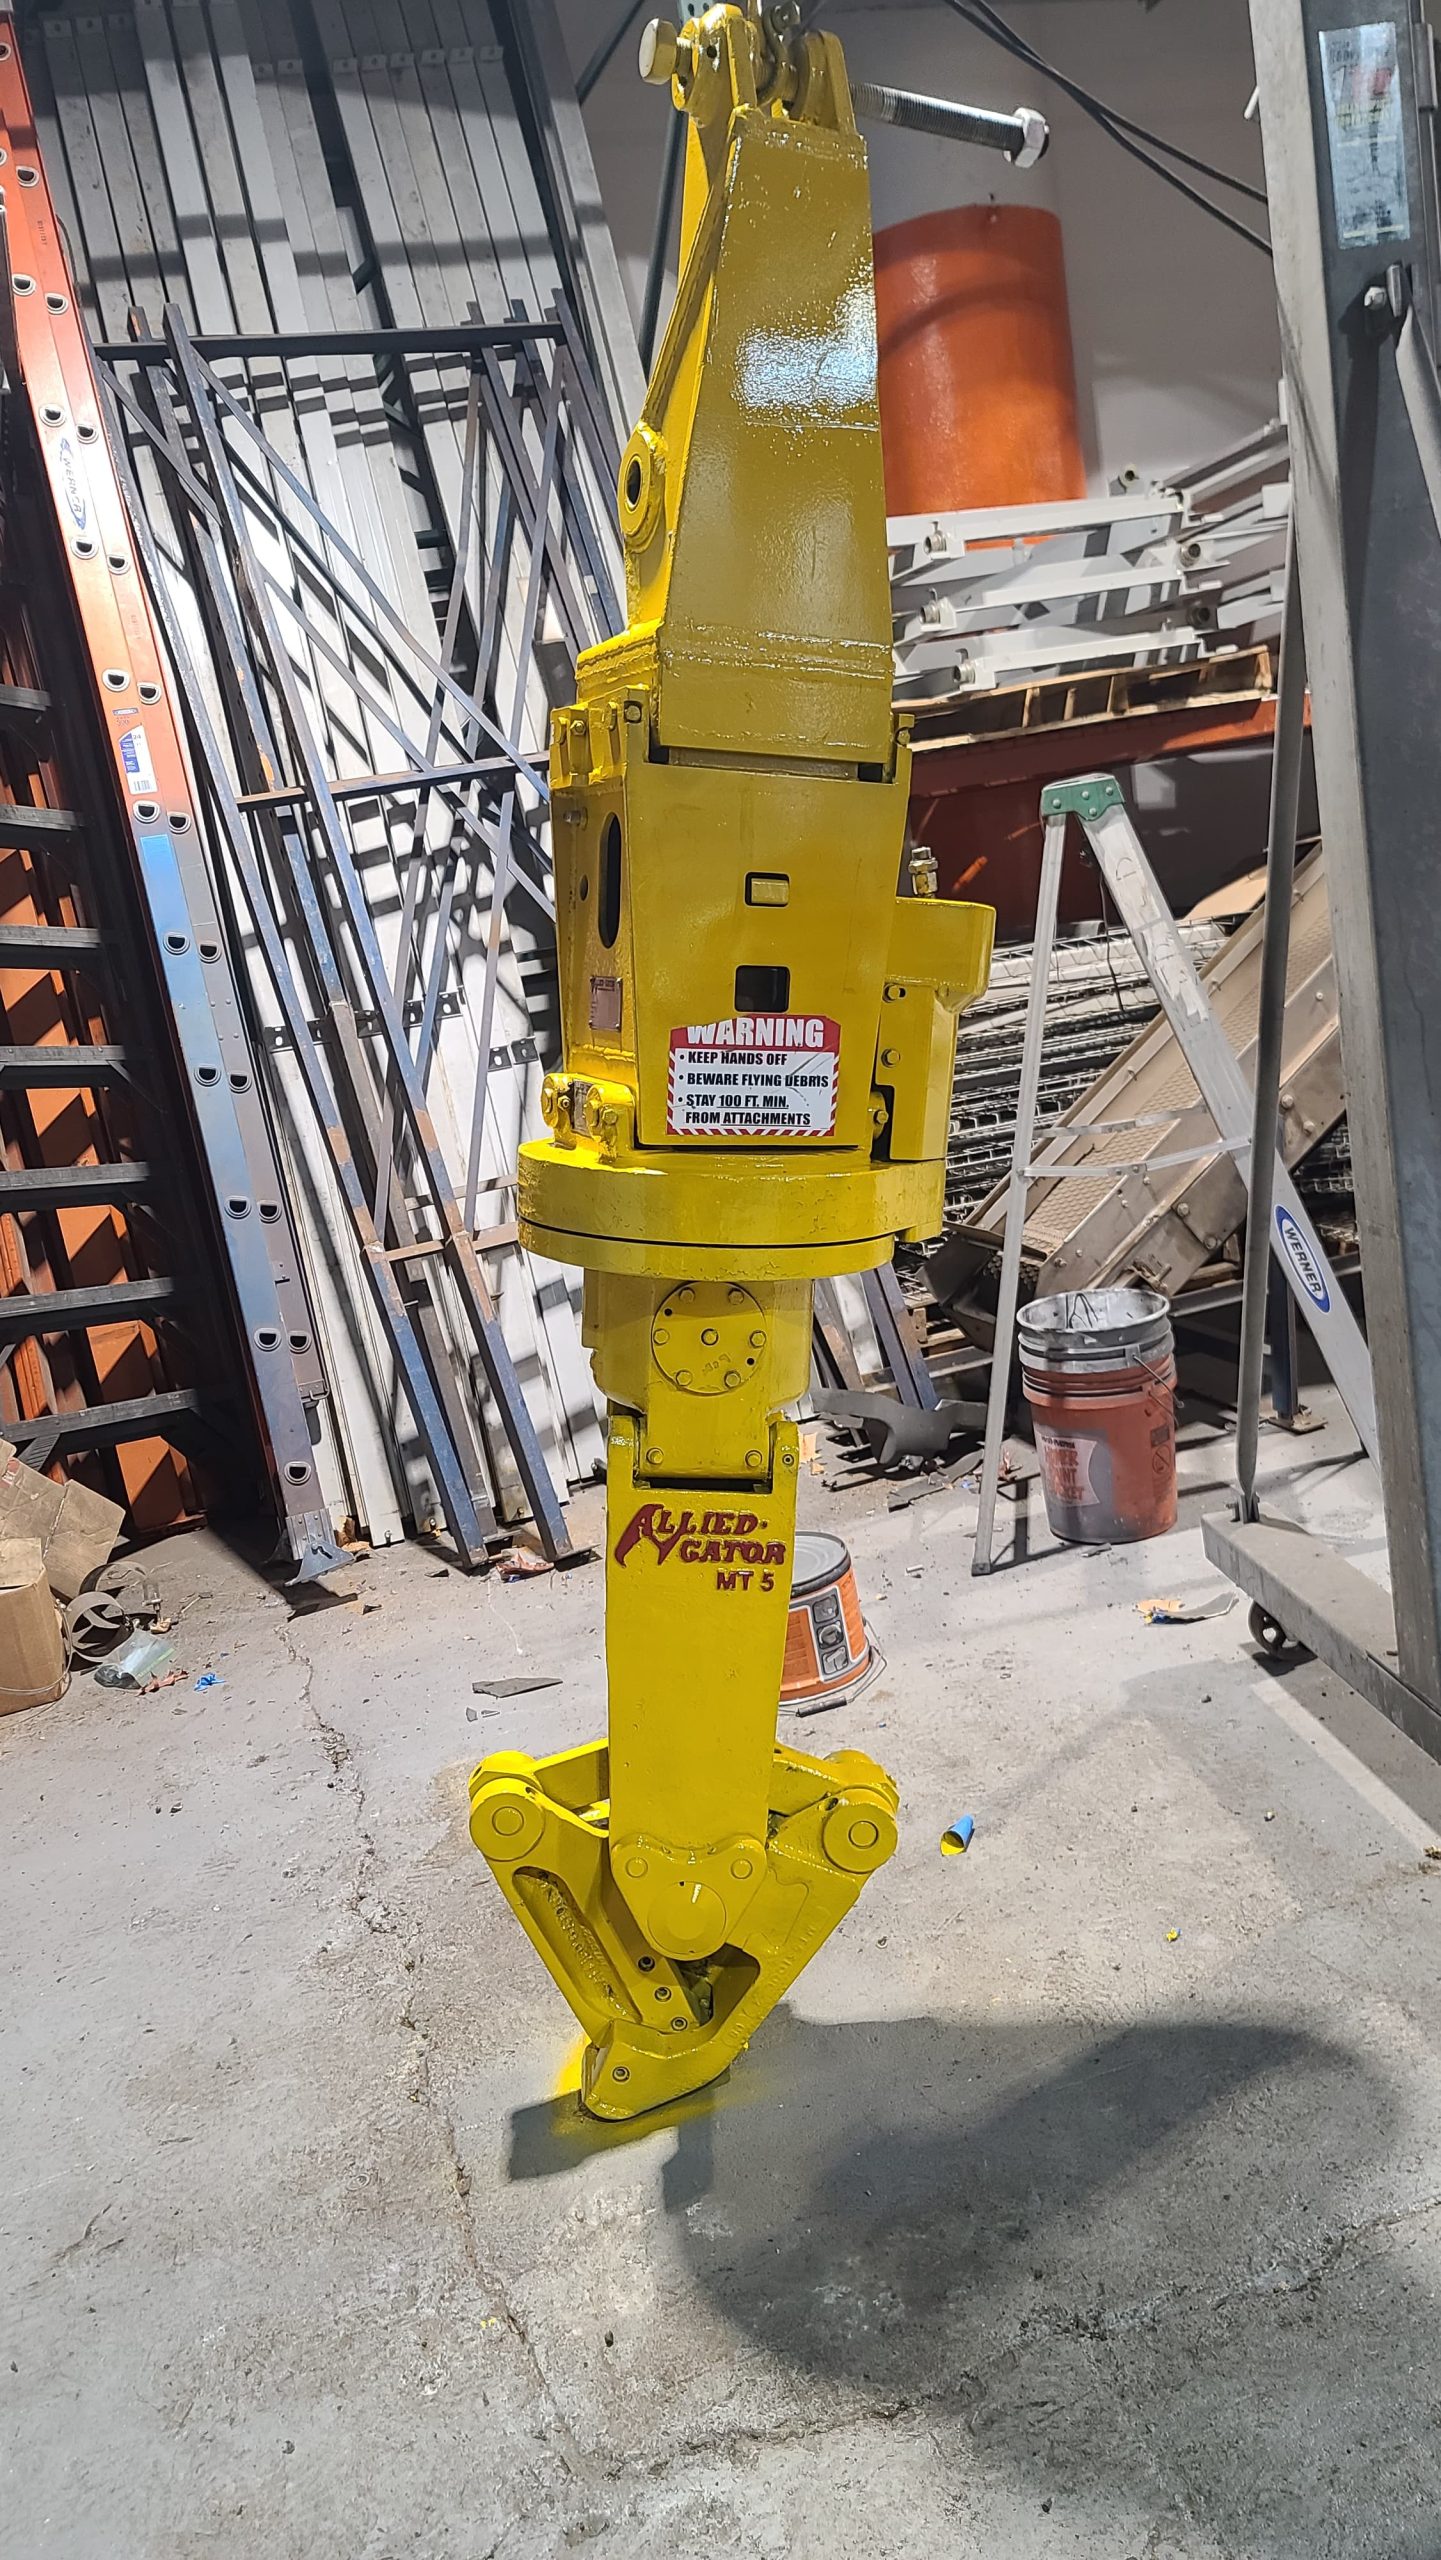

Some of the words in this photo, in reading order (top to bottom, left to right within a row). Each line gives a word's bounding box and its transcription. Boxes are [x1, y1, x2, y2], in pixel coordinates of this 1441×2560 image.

[686, 1017, 825, 1048] WARNING
[688, 1051, 718, 1064] KEEP
[721, 1051, 763, 1065] HANDS
[766, 1053, 788, 1066] OFF
[687, 1073, 739, 1086] BEWARE
[741, 1074, 782, 1087] FLYING
[785, 1075, 829, 1088] DEBRIS
[686, 1094, 716, 1107] STAY
[718, 1095, 741, 1107] 100
[744, 1095, 760, 1108] FT.
[762, 1096, 789, 1108] MIN.
[686, 1111, 720, 1124] FROM
[722, 1112, 811, 1125] ATTACHMENTS
[1284, 1226, 1323, 1293] WERNER
[680, 1538, 787, 1566] GATOR
[716, 1569, 755, 1592] MT
[761, 1570, 775, 1593] 5
